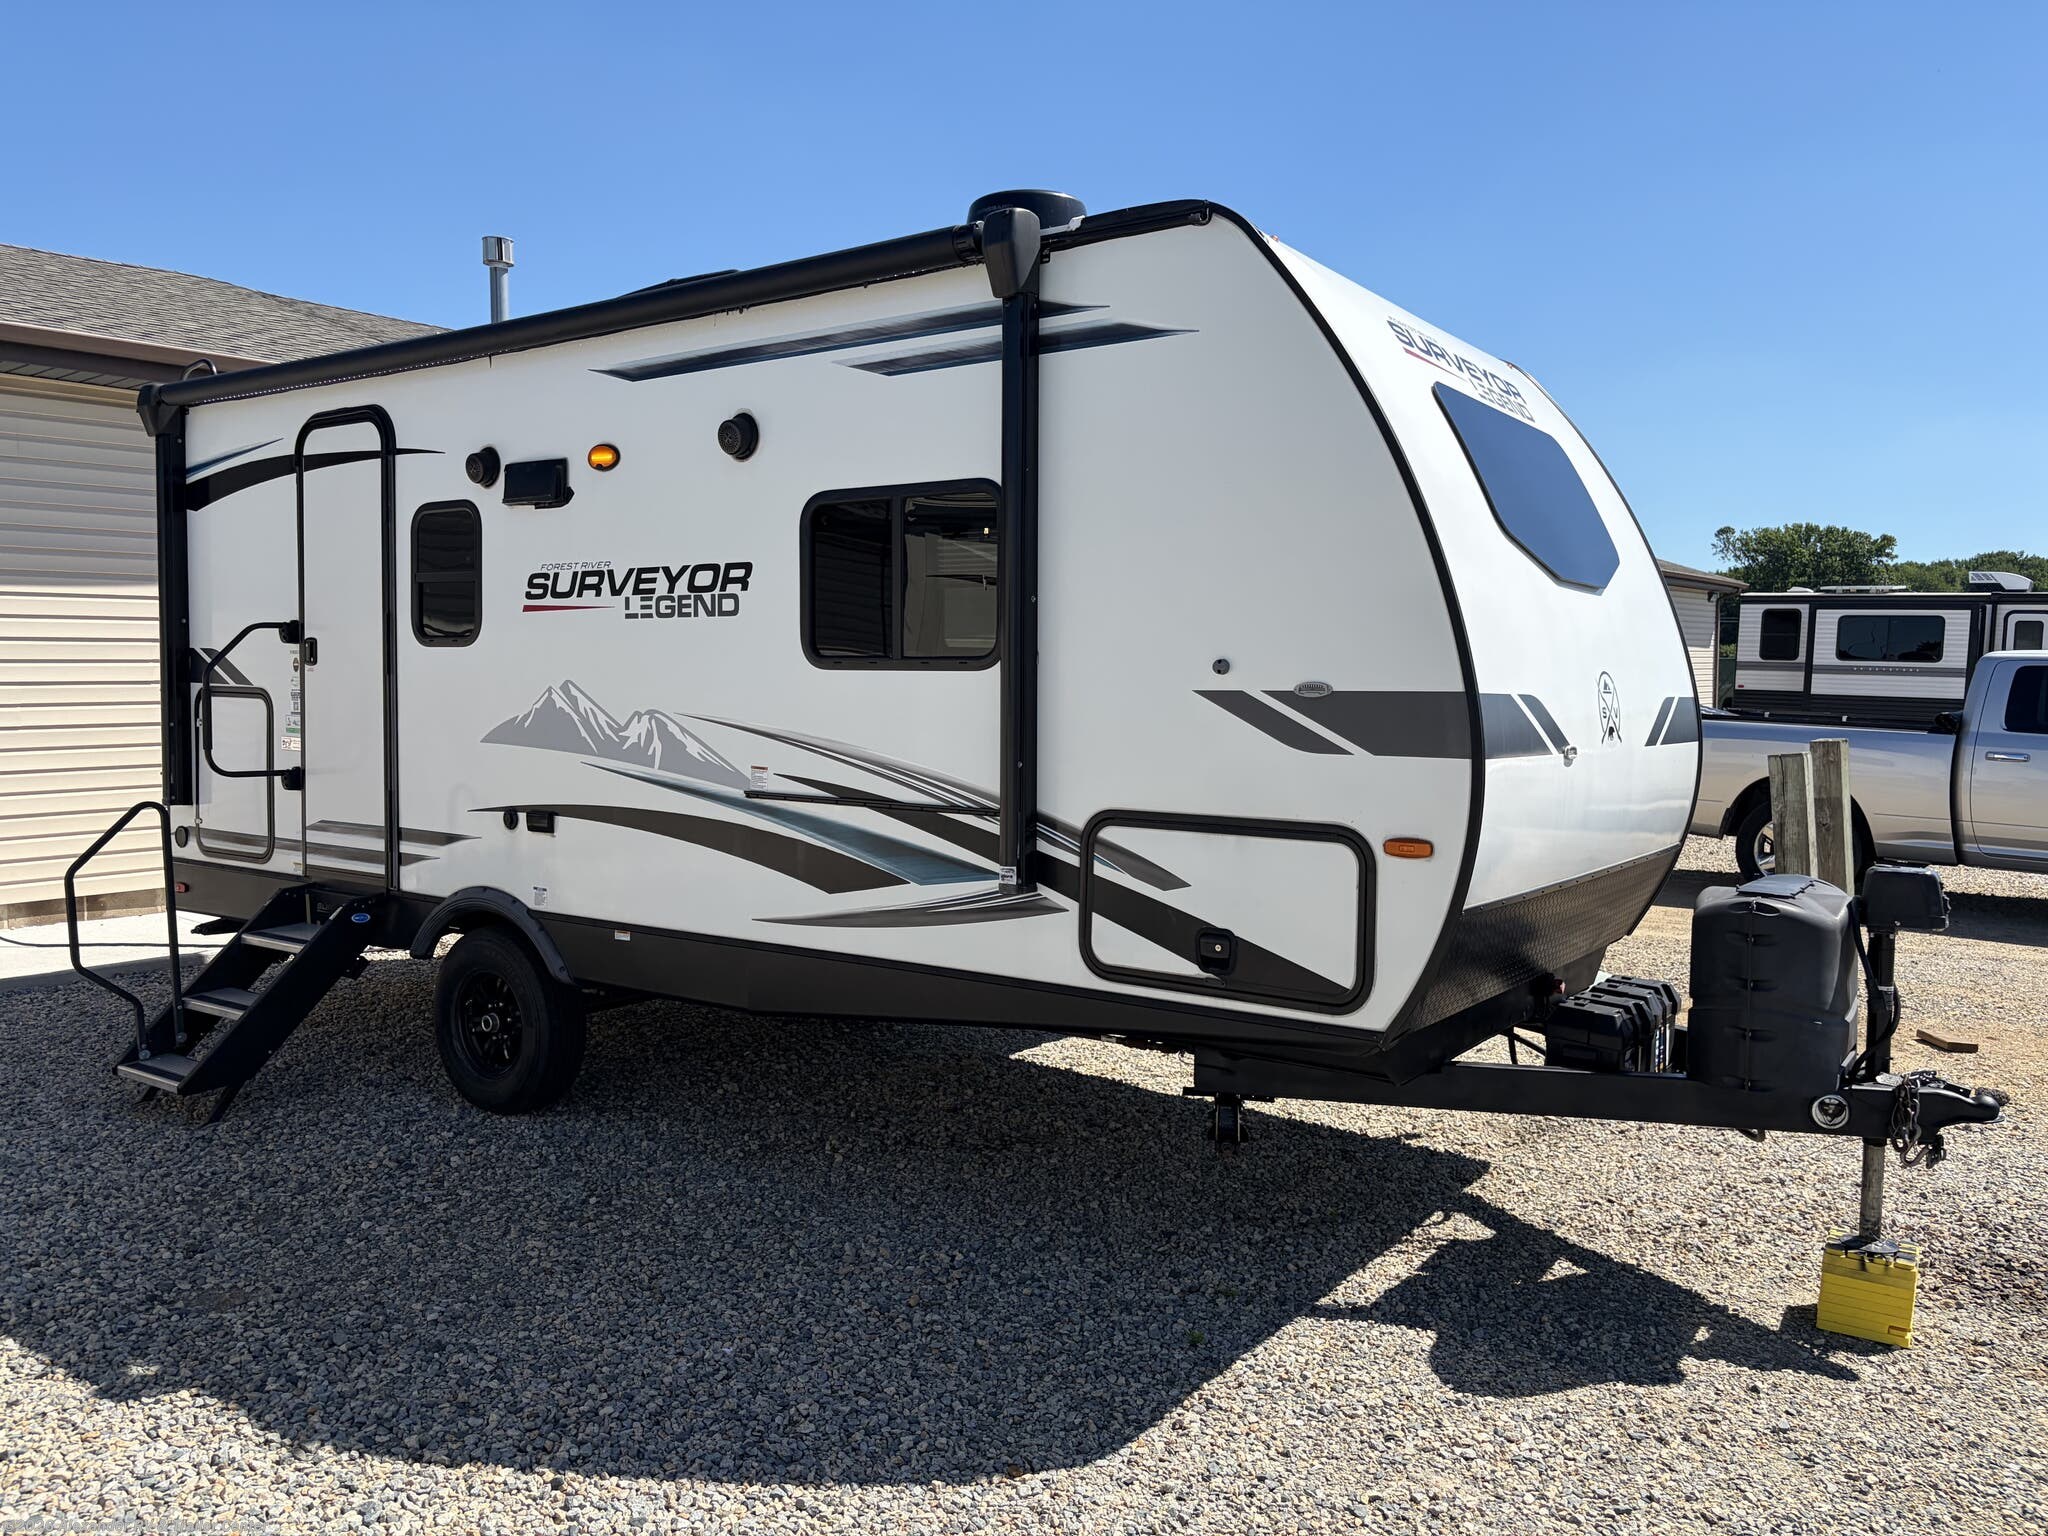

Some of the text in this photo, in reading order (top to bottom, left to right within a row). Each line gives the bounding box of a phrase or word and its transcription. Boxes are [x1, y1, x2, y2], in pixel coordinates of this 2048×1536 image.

[1386, 319, 1527, 405] SURVEYOR
[1468, 377, 1536, 423] LEGEND
[525, 561, 753, 600] SURVEYOR
[540, 560, 611, 571] FOREST RIVER
[624, 592, 740, 619] LEGEND
